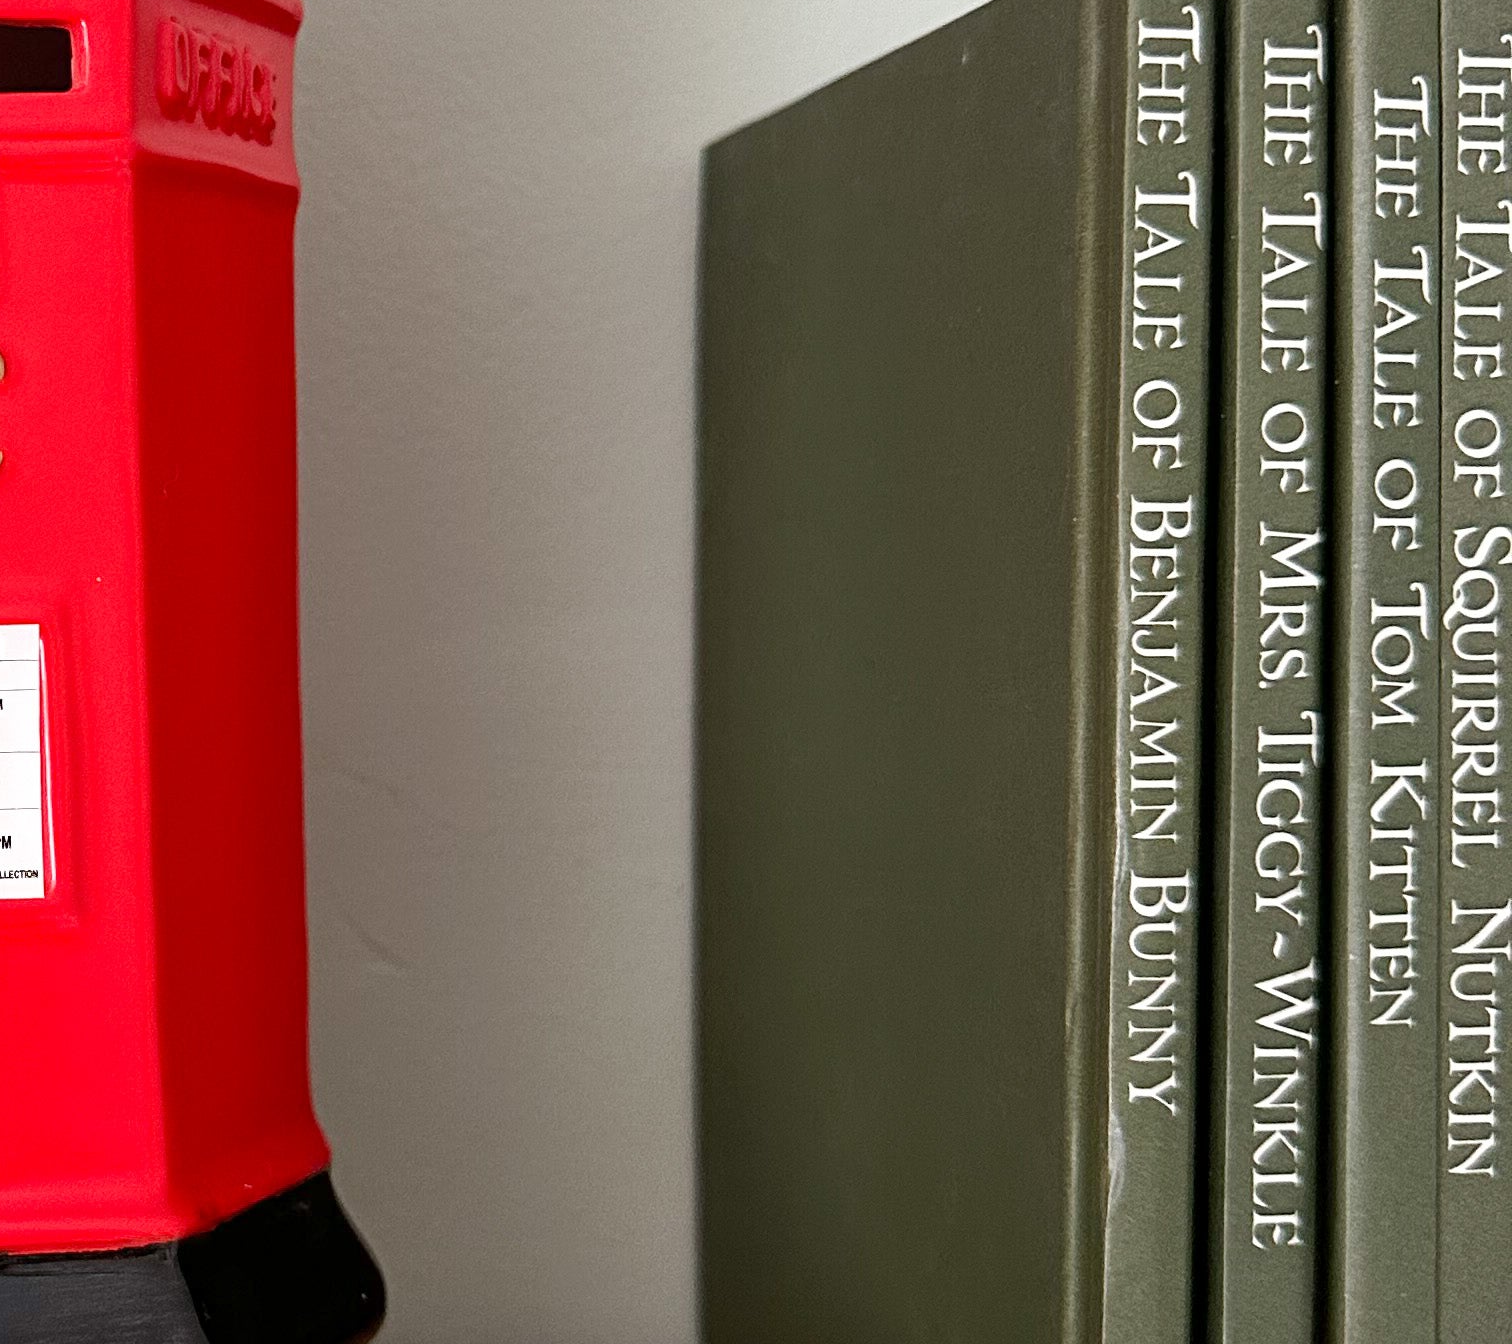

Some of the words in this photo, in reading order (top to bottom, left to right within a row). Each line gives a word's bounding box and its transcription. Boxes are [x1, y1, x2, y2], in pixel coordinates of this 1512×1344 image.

[1135, 5, 1201, 146] THE
[1263, 24, 1323, 167] THE
[1373, 75, 1431, 219] THE
[1457, 33, 1512, 176] THE
[1132, 171, 1199, 351] TALE
[1260, 191, 1322, 374] TALE
[1373, 245, 1432, 429] TALE
[1453, 199, 1512, 381] TALE
[1131, 379, 1183, 470] OF
[1260, 402, 1311, 493] OF
[1372, 458, 1421, 551] OF
[1453, 409, 1505, 498] OF
[1128, 494, 1194, 844] BENJAMIN
[1258, 521, 1320, 689] MRS.
[1370, 582, 1429, 730] TOM
[1442, 526, 1512, 869] SQUIRREL
[1368, 758, 1428, 1028] KITTEN
[1127, 867, 1192, 1116] BUNNY
[1447, 898, 1512, 1178] NUTKIN
